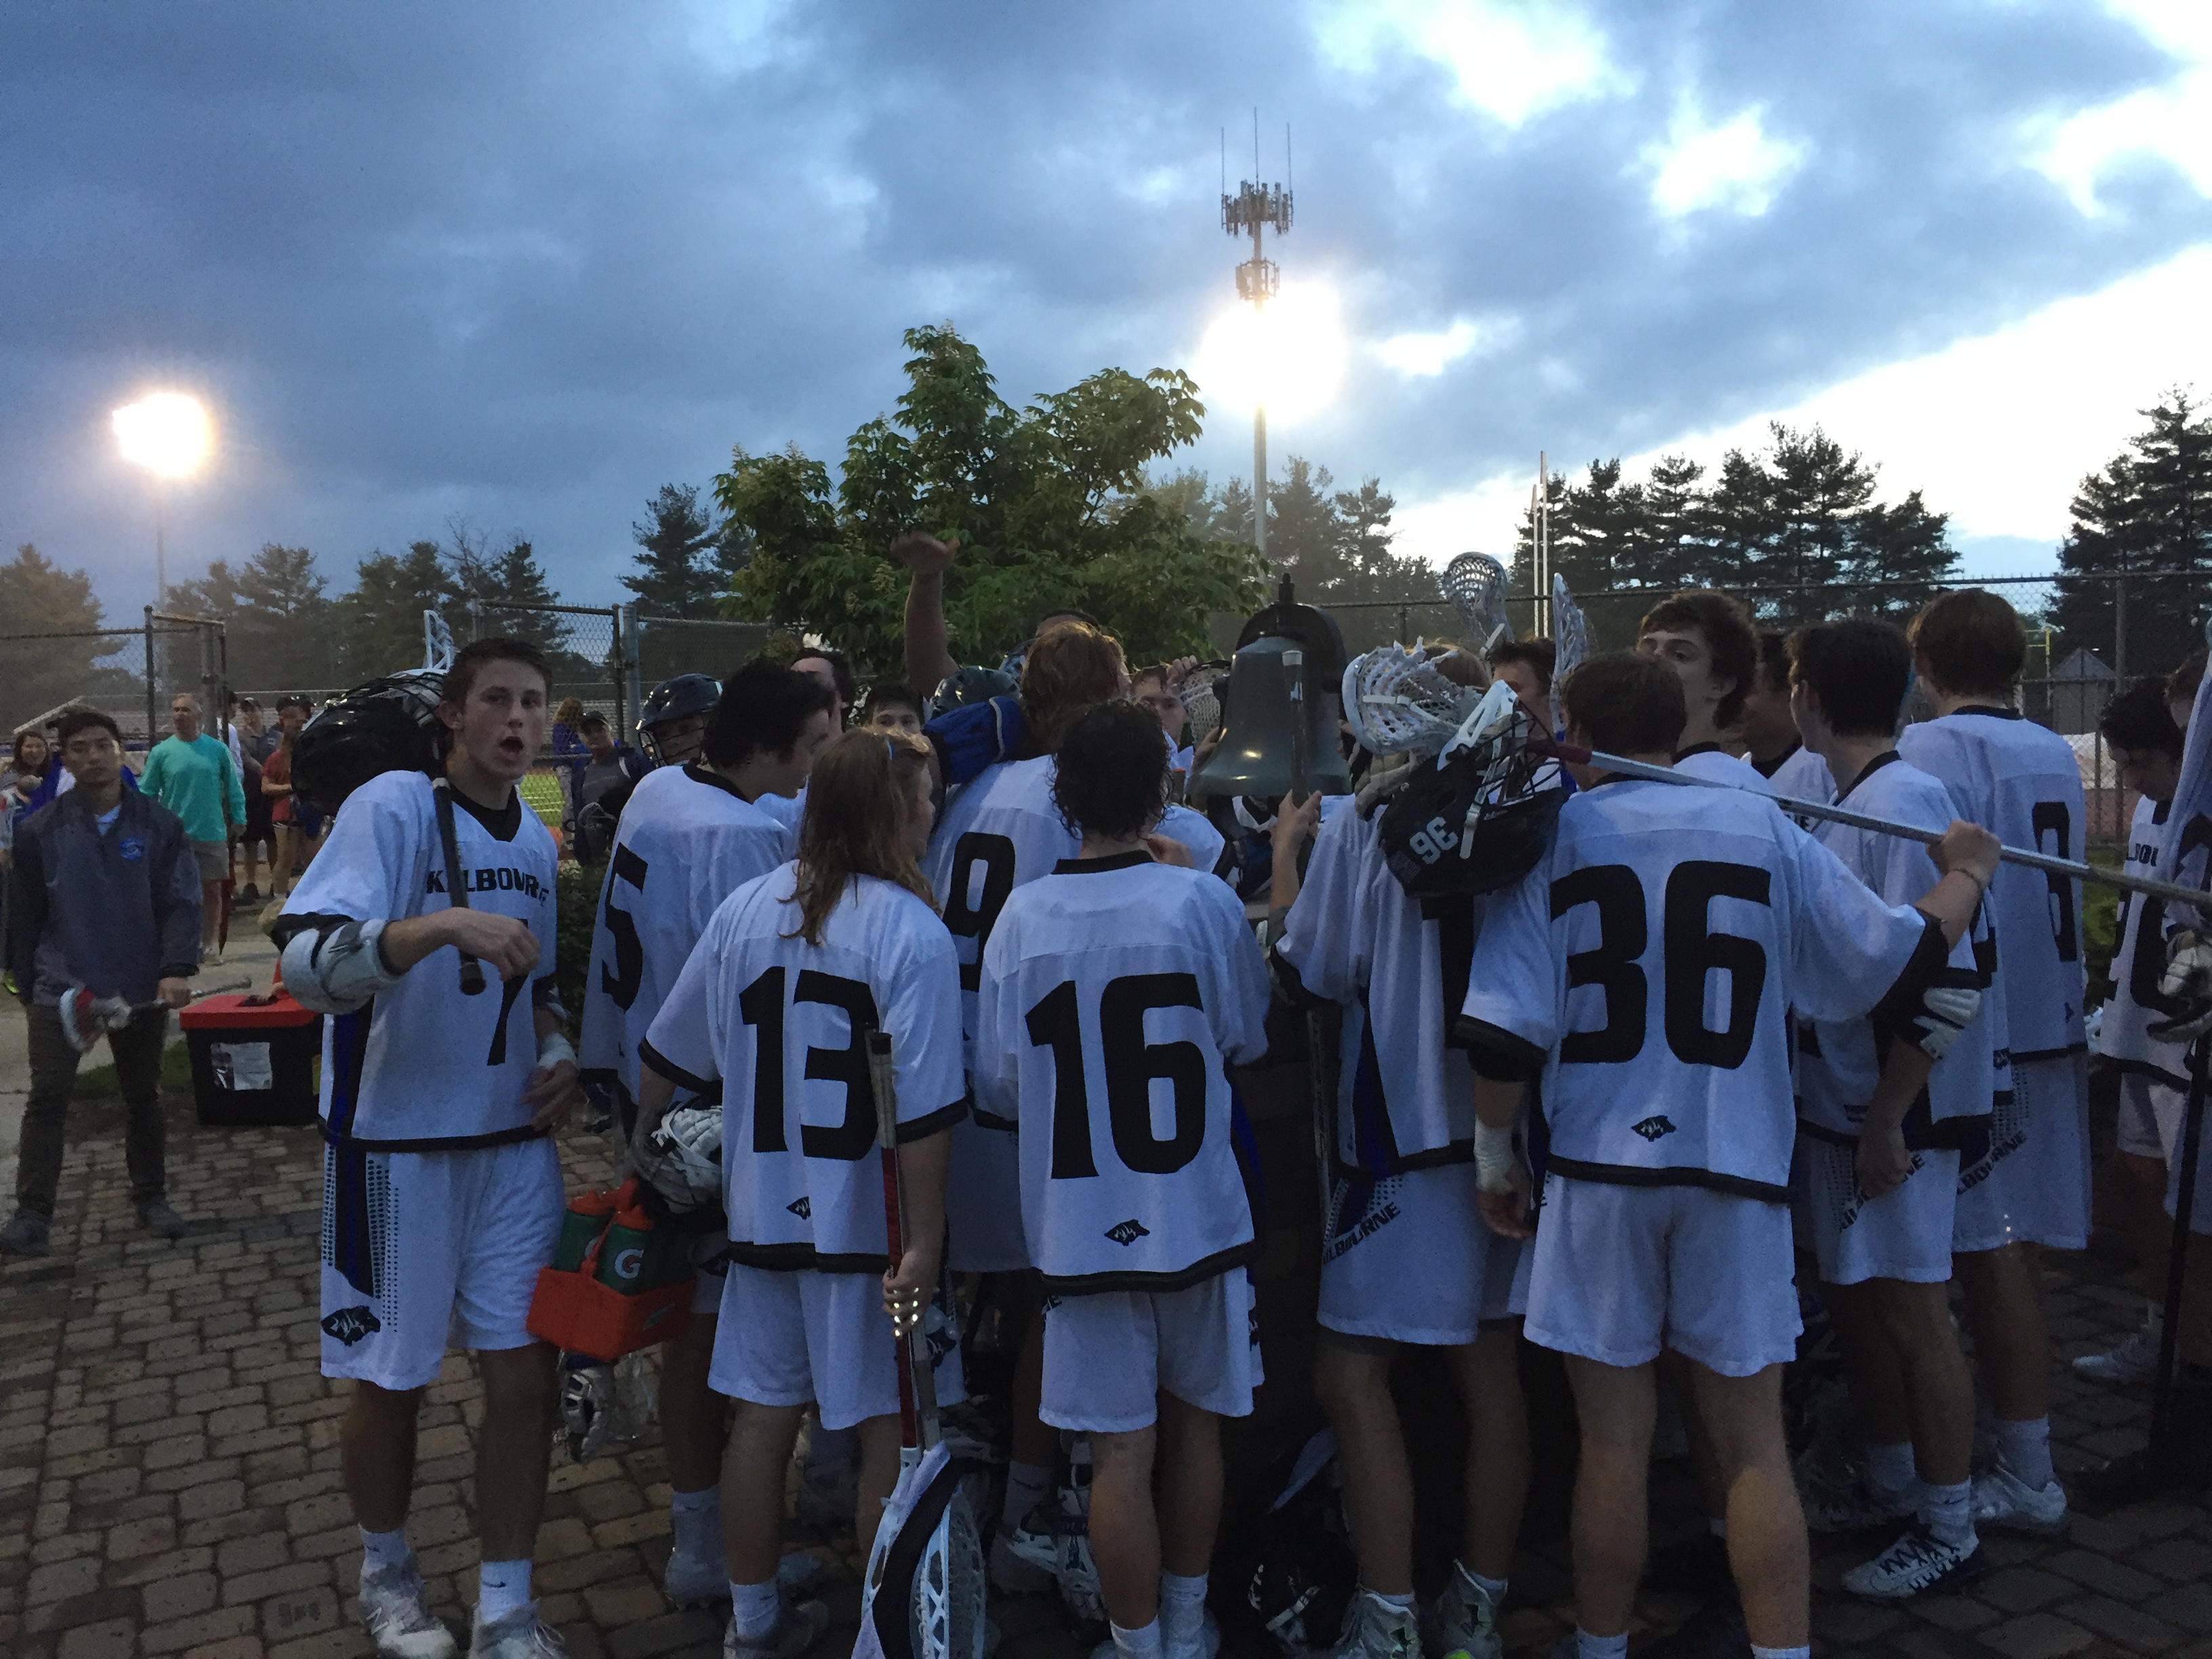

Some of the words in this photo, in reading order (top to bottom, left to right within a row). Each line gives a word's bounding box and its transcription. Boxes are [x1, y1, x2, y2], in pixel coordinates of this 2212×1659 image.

[739, 966, 880, 1161] 13
[1550, 860, 1771, 1069] 36
[1024, 972, 1207, 1180] 16
[614, 1248, 644, 1279] G
